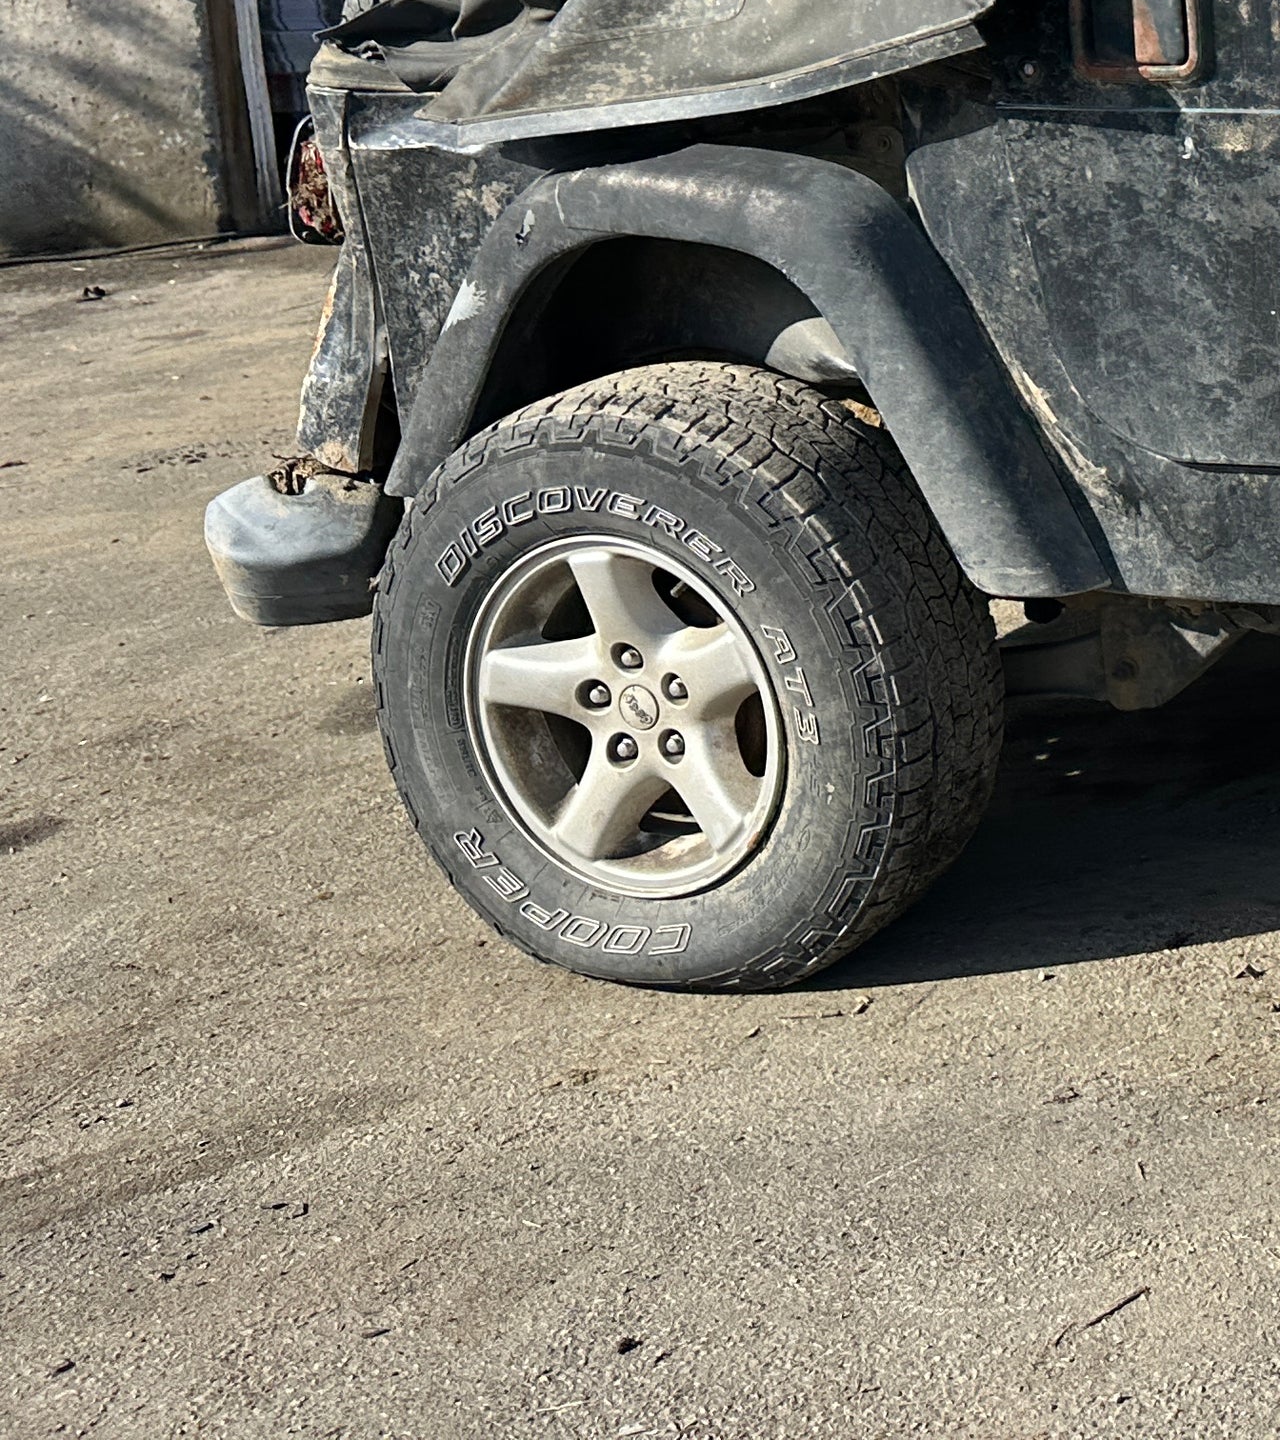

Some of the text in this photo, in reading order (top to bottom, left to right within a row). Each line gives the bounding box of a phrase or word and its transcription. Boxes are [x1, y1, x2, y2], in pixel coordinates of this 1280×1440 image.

[434, 485, 822, 747] DISCOVERER AT3
[453, 826, 693, 957] COOPER
